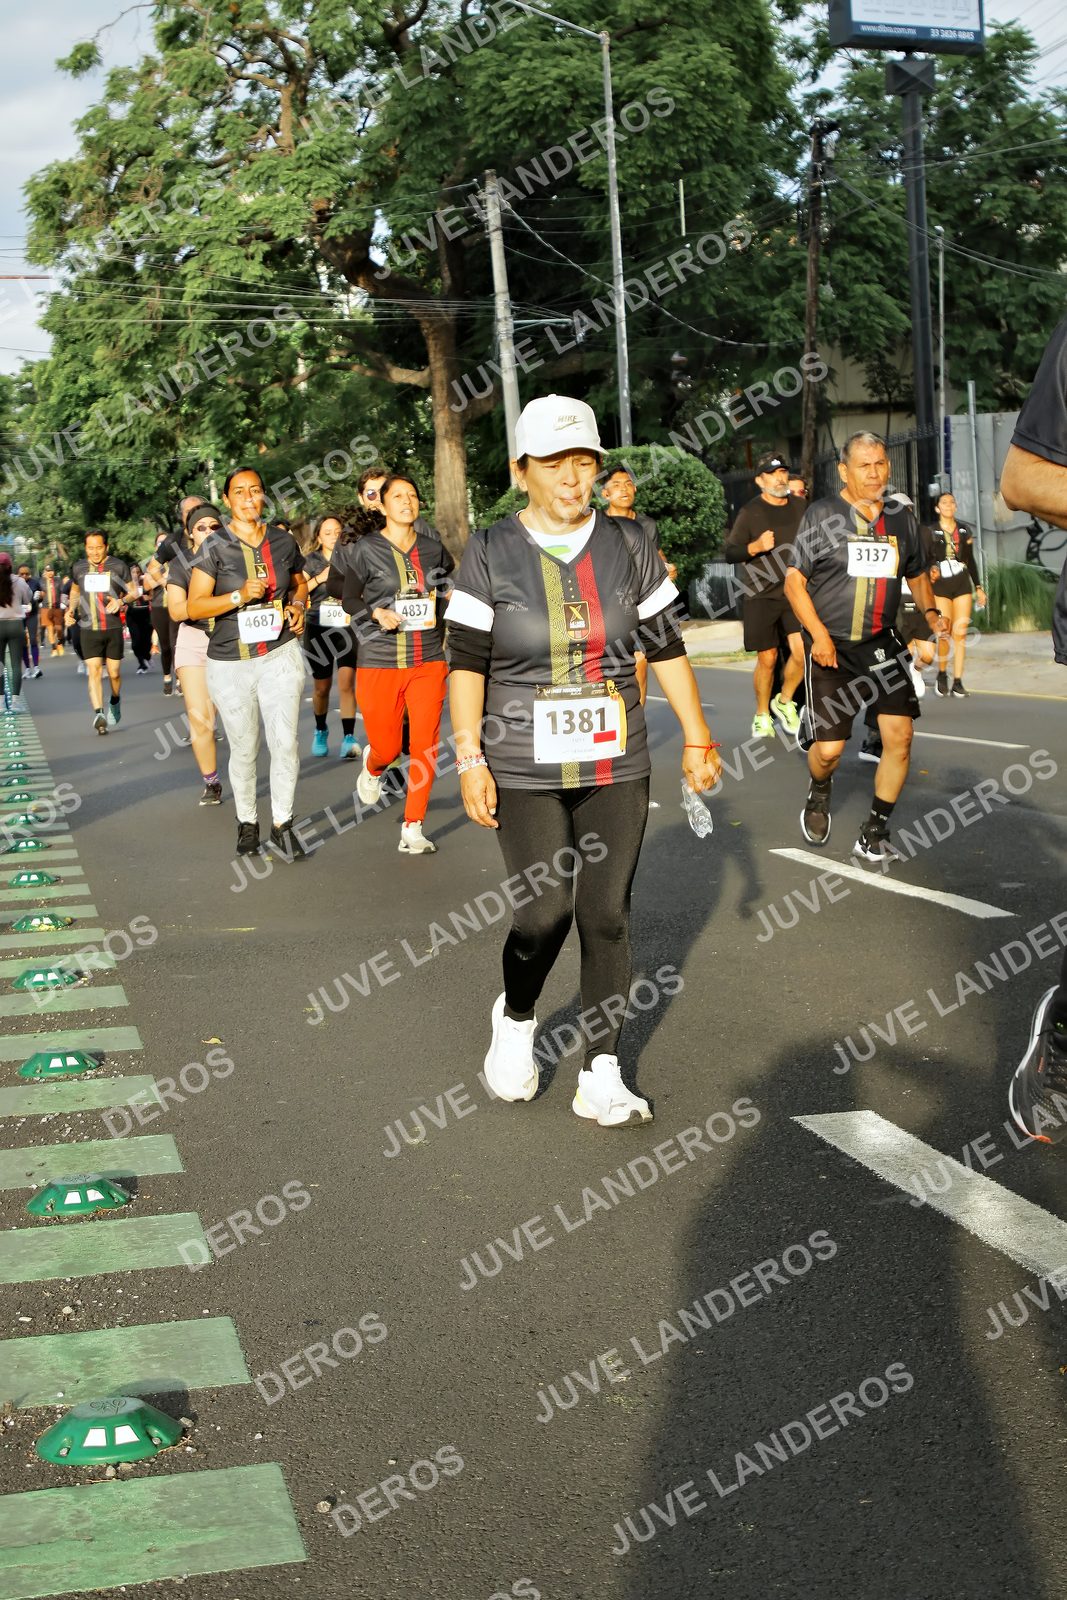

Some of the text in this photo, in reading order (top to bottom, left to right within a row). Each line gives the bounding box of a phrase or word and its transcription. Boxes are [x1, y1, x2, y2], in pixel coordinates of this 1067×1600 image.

[856, 547, 888, 562] 3137
[327, 609, 342, 618] 506
[402, 604, 427, 617] 4837
[245, 614, 275, 628] 4687
[546, 707, 605, 735] 1381
